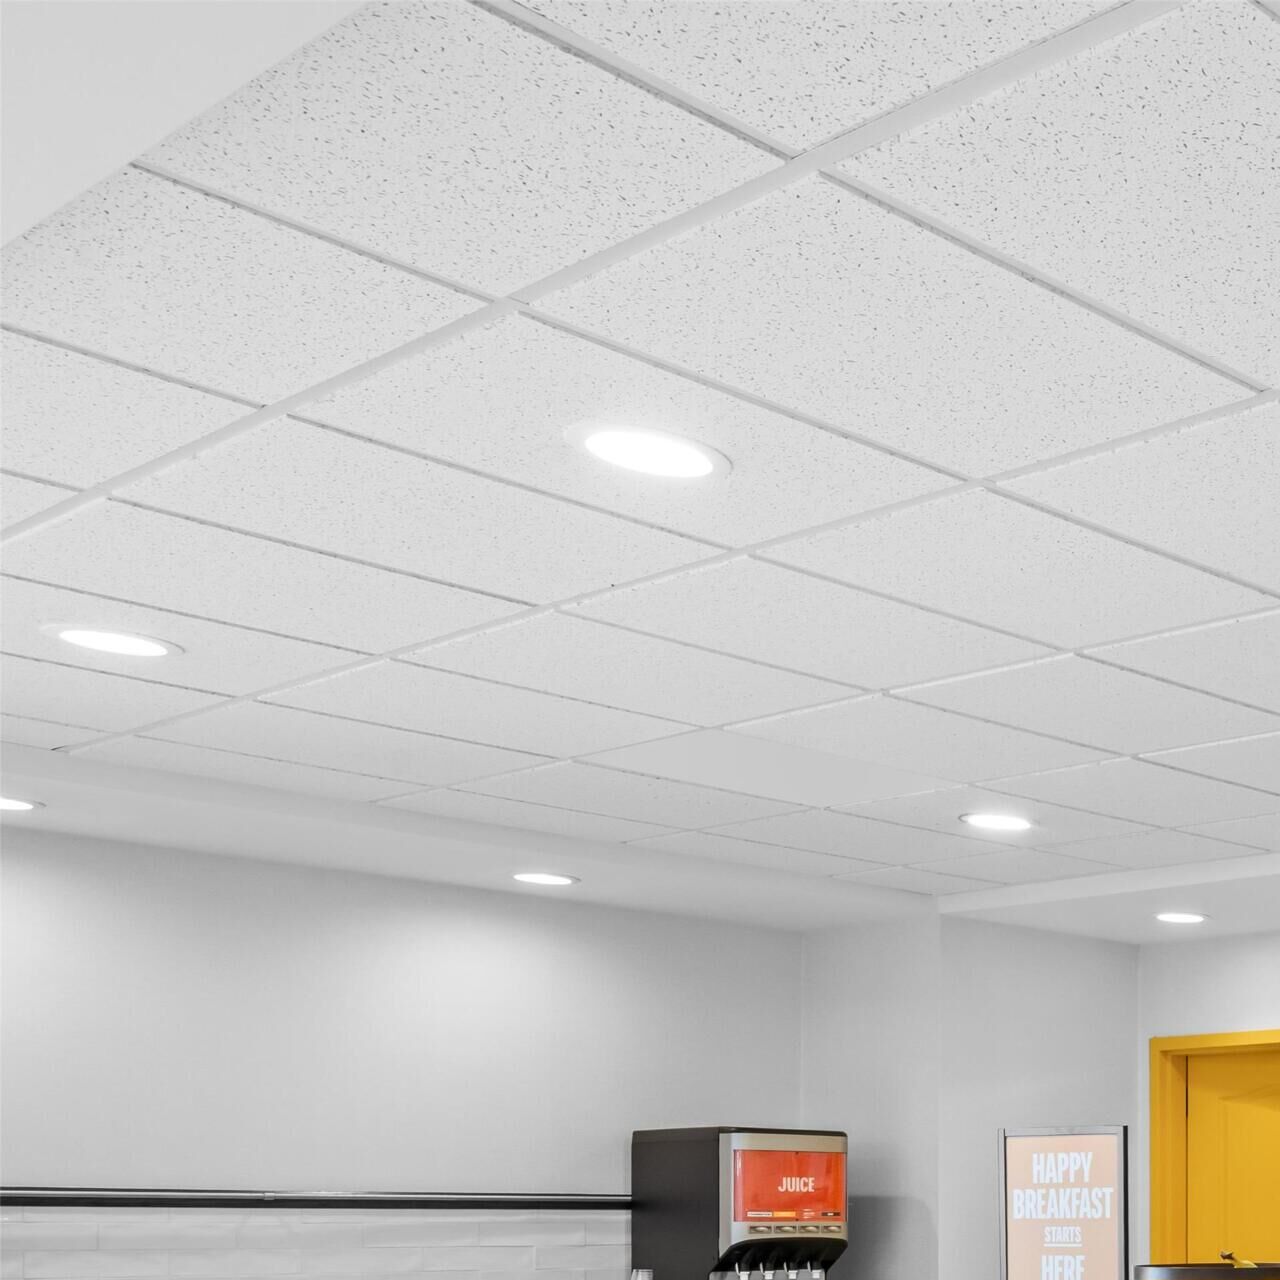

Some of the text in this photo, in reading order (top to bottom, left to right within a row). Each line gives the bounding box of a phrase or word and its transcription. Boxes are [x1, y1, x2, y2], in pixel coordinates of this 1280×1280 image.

[1032, 1152, 1093, 1184] HAPPY
[778, 1177, 815, 1192] JUICE
[1012, 1187, 1113, 1219] BREAKFAST
[1044, 1226, 1082, 1244] STARTS
